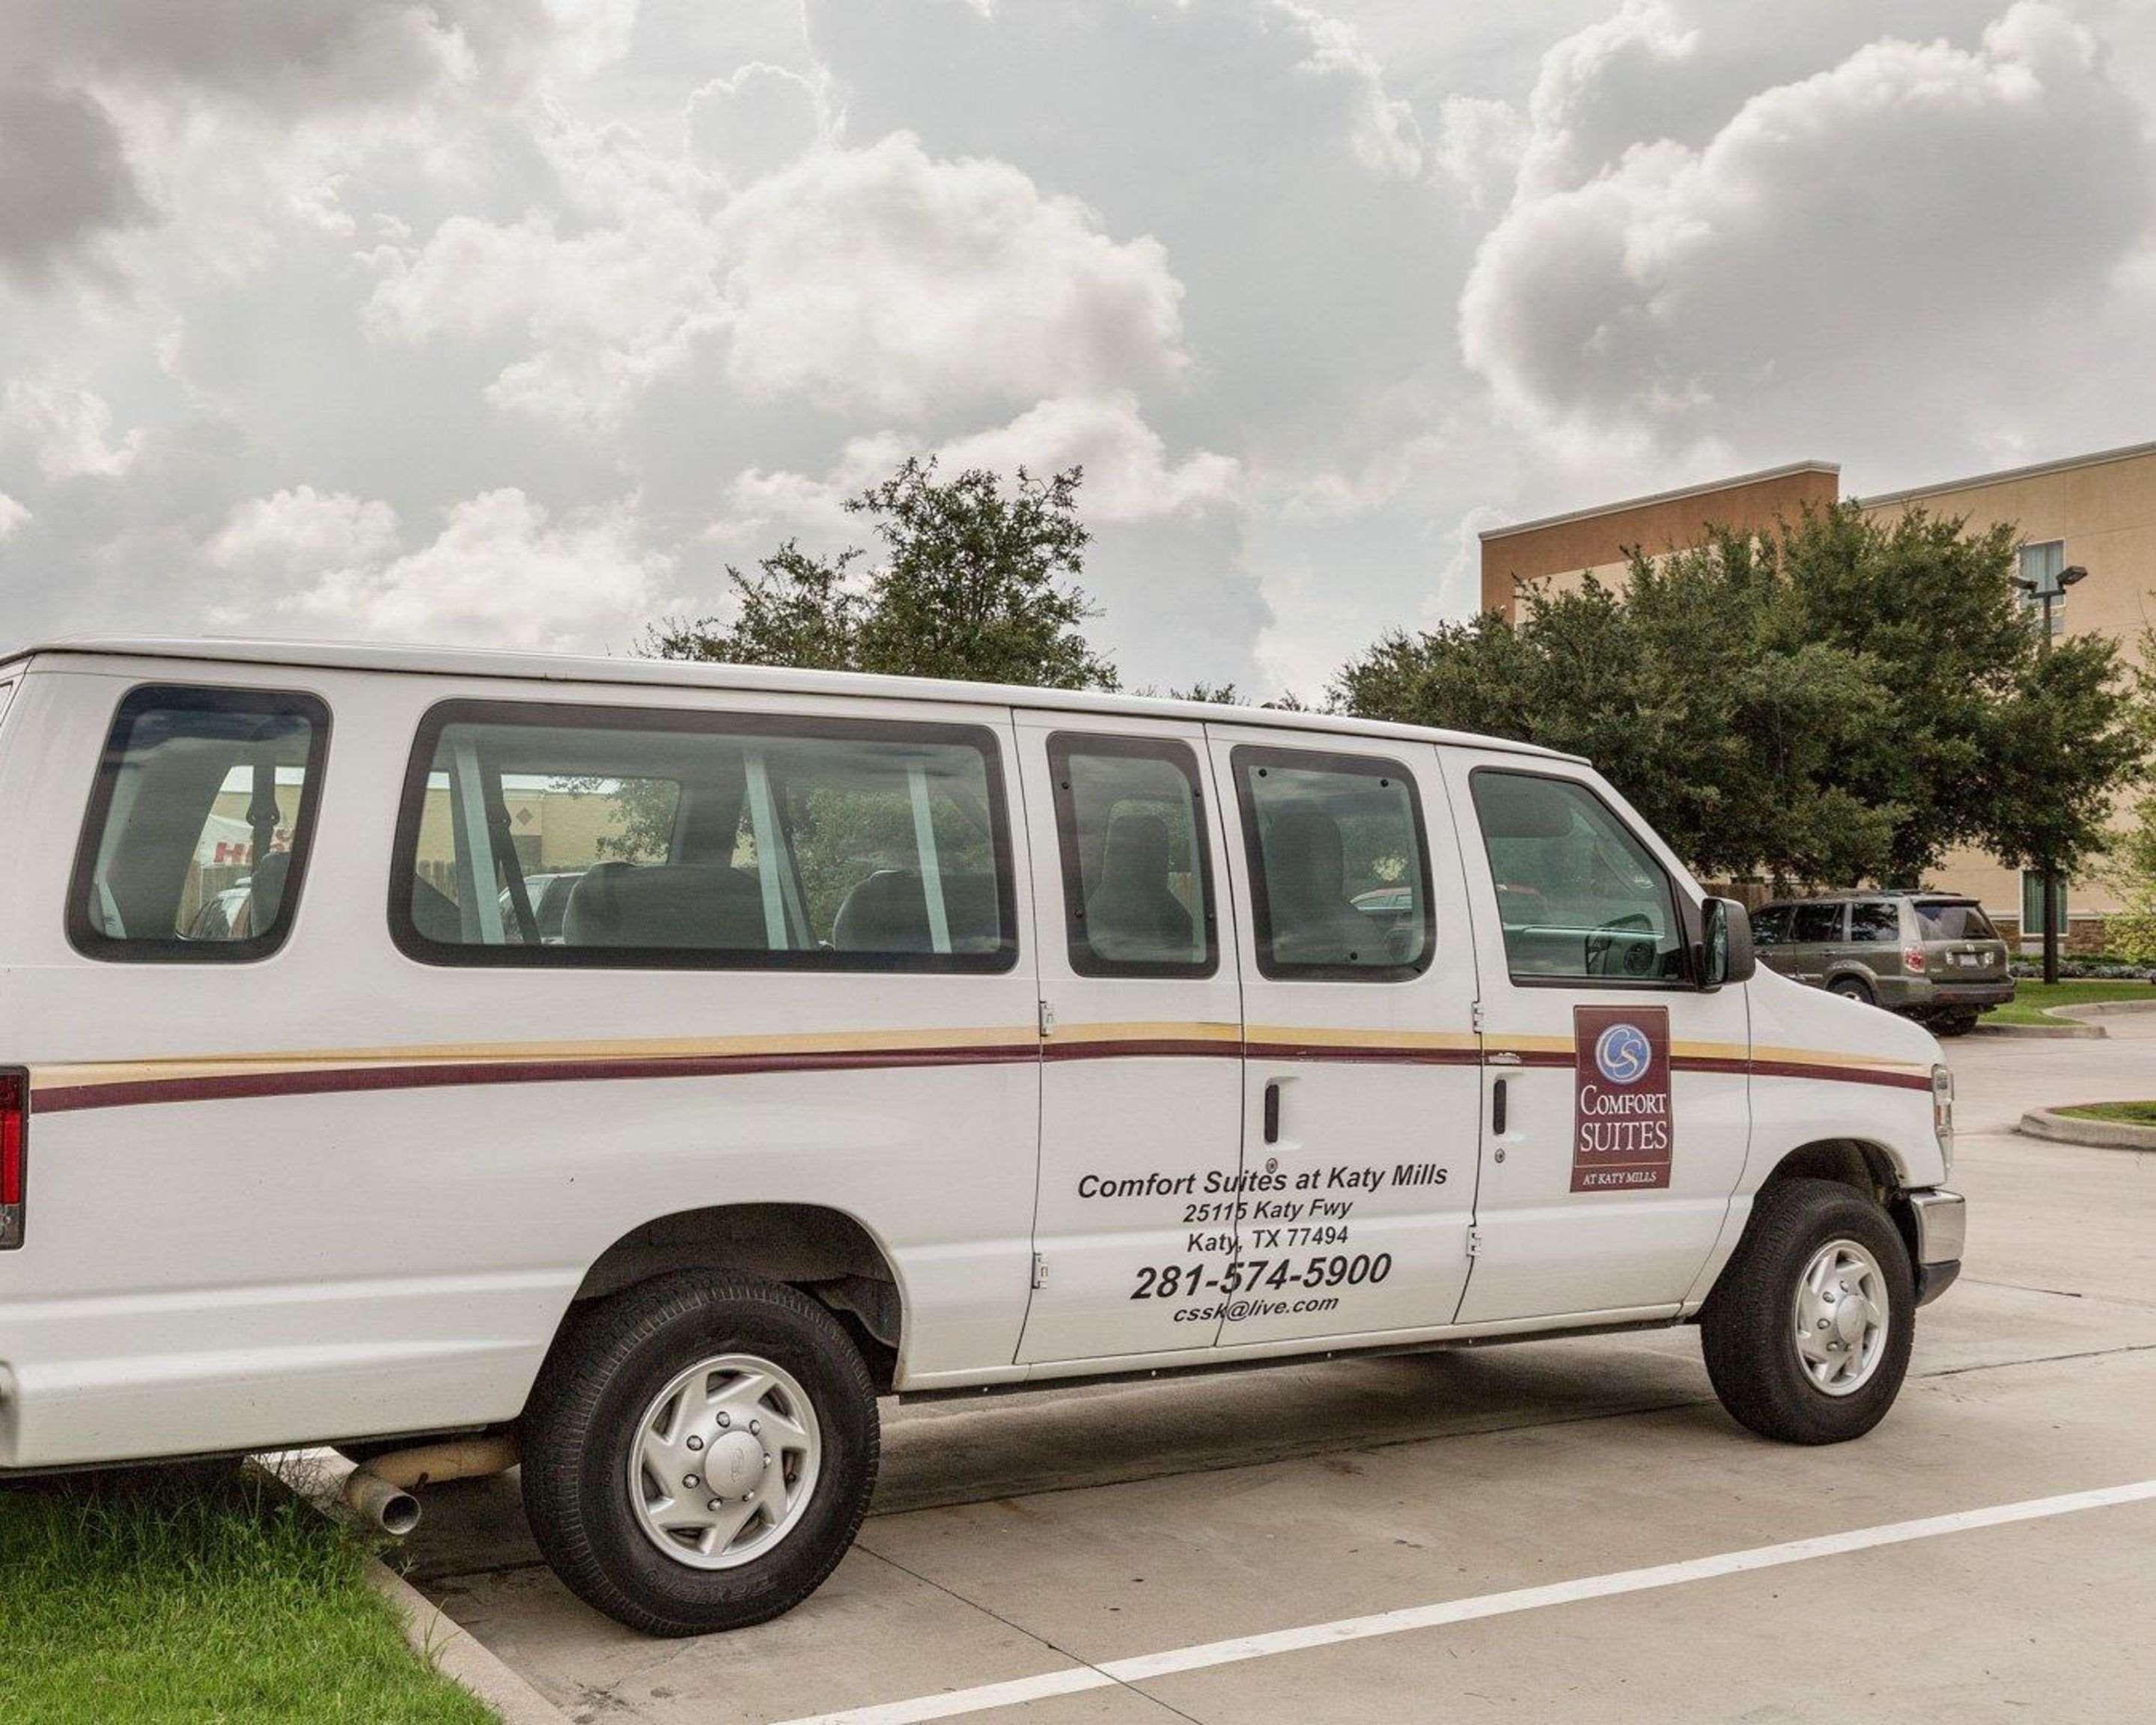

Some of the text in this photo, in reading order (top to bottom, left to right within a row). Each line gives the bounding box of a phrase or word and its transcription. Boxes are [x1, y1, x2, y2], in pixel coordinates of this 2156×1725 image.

[1580, 1084, 1667, 1116] COMFORT
[1580, 1120, 1668, 1152] SUITES
[1078, 1163, 1448, 1199] Comfort Suites at Katy Mills
[1581, 1171, 1657, 1185] AT KATY MILLS
[1183, 1198, 1354, 1223] 25115 Katy Fwy
[1187, 1226, 1348, 1256] Katy, TX 77494
[1130, 1253, 1392, 1300] 281-574-5900
[1173, 1296, 1339, 1322] cssk@live.com
